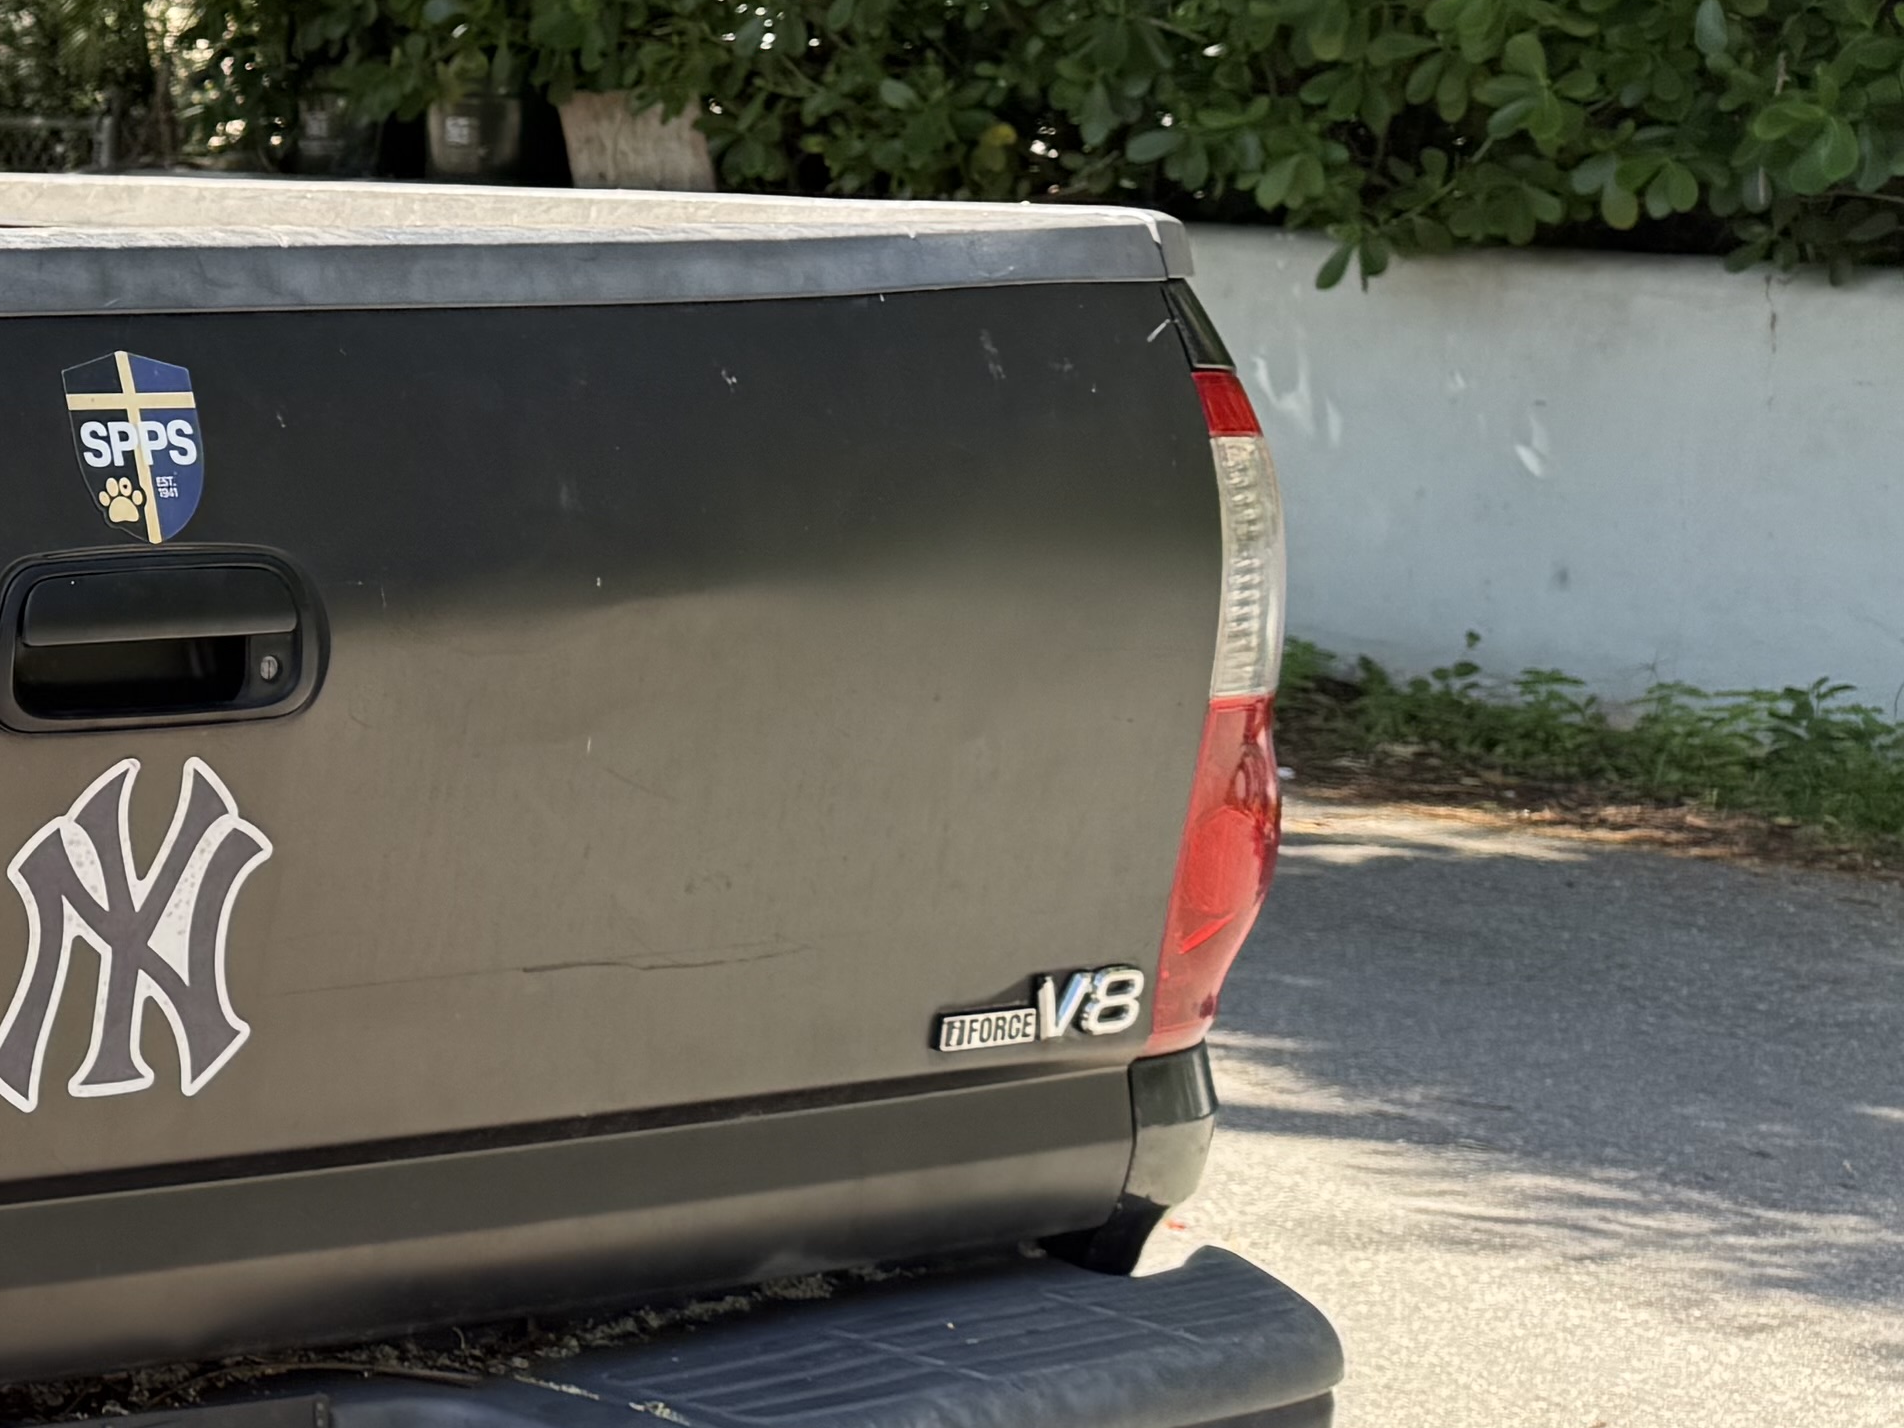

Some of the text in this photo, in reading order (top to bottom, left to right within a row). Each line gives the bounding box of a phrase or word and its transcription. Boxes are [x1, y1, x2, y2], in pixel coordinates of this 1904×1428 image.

[80, 419, 197, 468] SPPS
[155, 475, 177, 488] EST.
[1038, 966, 1145, 1039] V8
